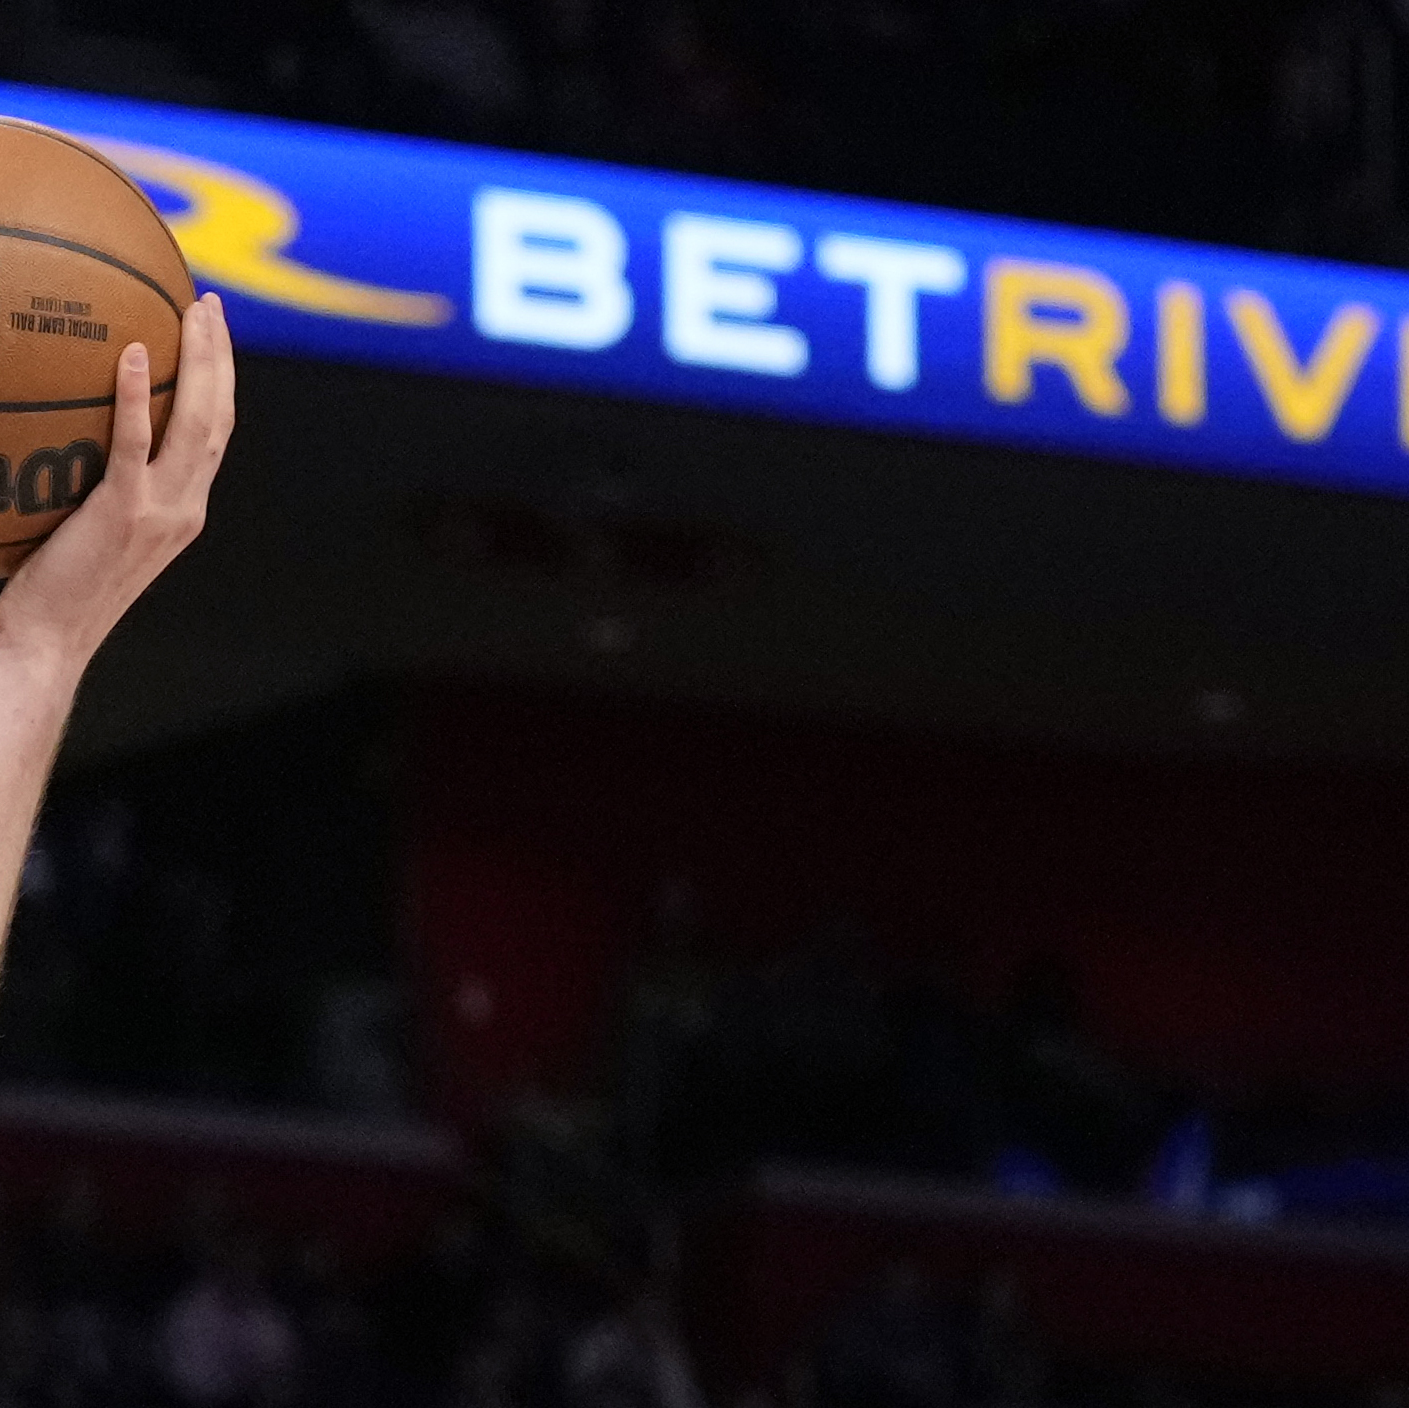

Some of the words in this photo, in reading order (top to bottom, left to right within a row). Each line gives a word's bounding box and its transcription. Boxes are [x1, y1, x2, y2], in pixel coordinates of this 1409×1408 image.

[10, 312, 35, 332] BALL
[37, 315, 65, 336] GAME
[471, 185, 1409, 453] BETRIV
